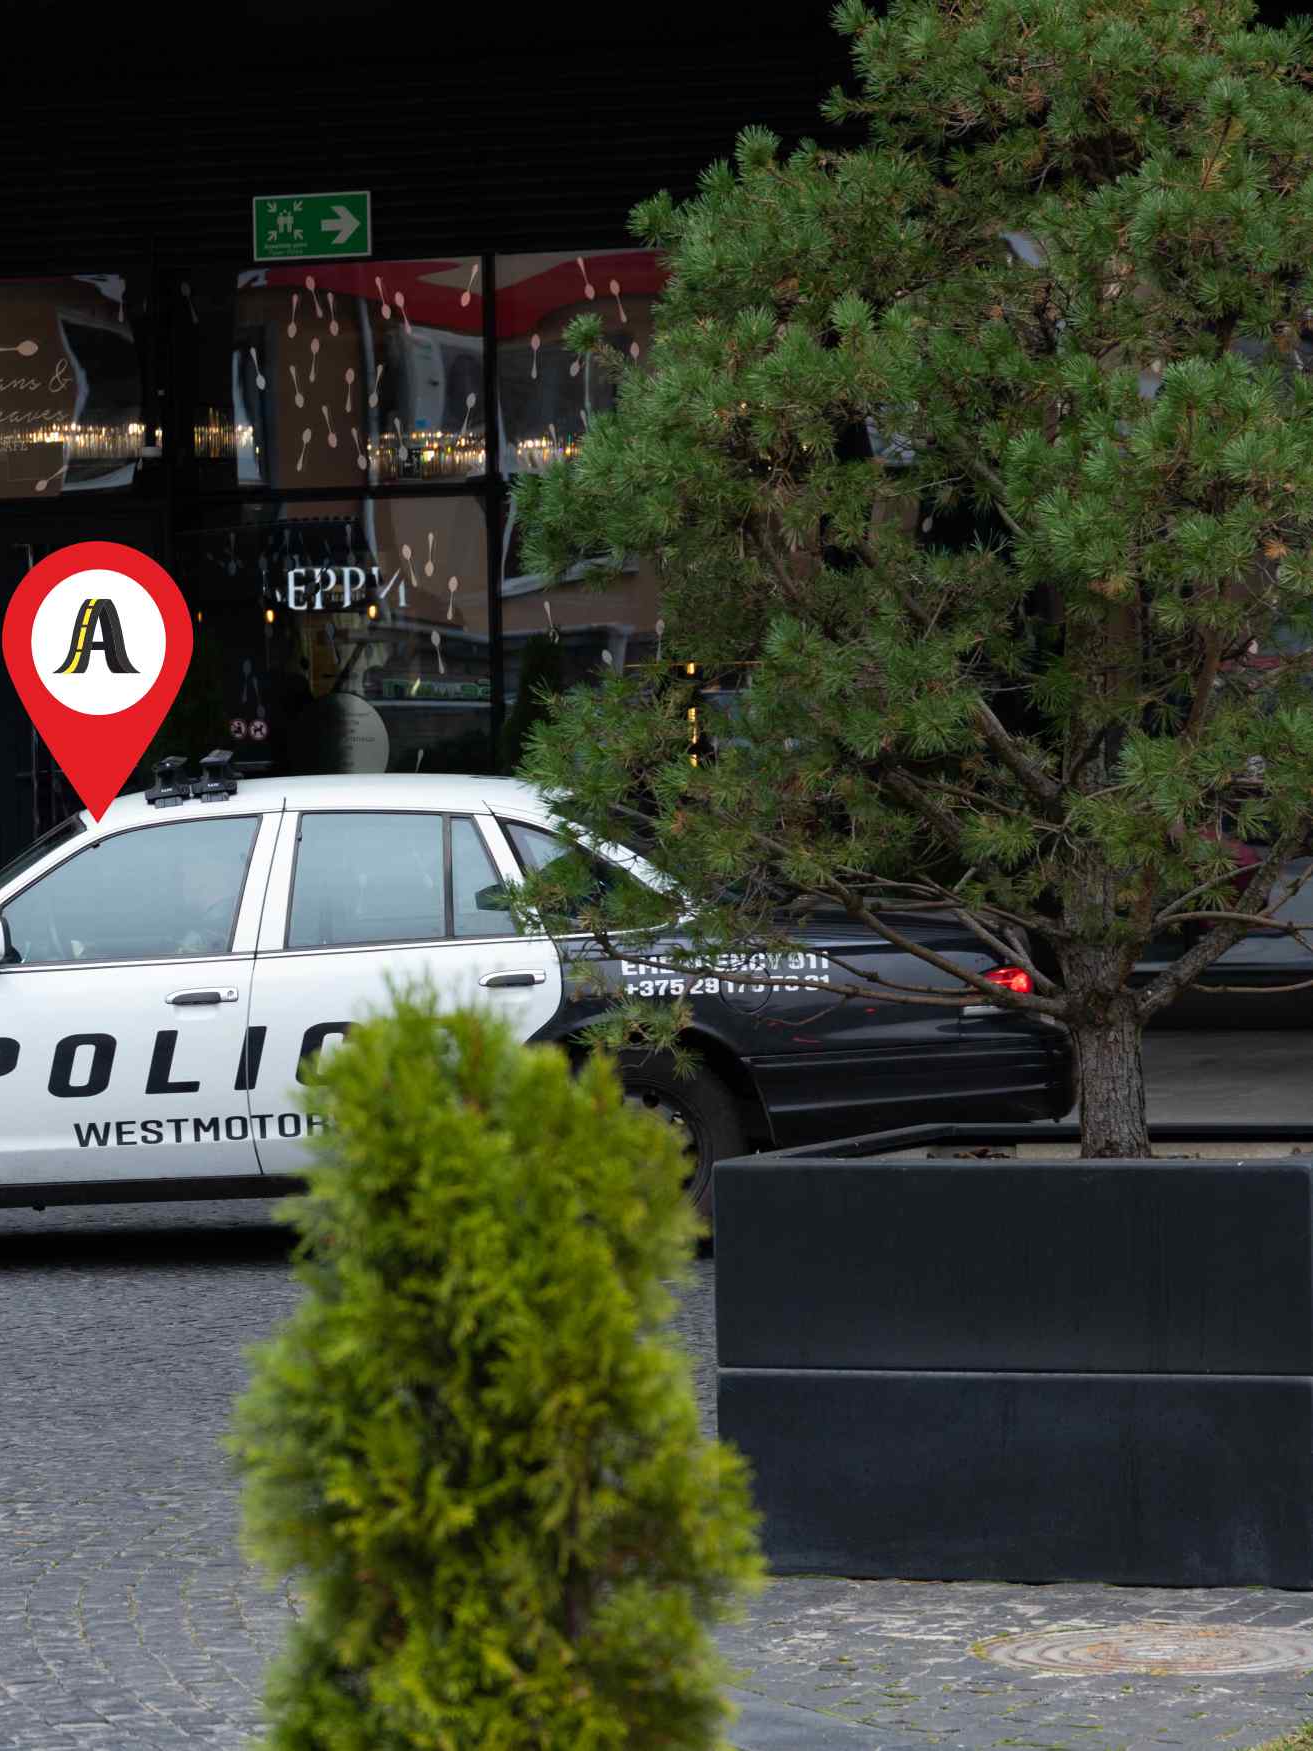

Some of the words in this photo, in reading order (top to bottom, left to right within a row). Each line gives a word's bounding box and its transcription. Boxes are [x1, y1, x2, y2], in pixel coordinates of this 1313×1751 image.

[48, 359, 72, 393] &
[788, 951, 830, 970] 911
[624, 978, 686, 997] +375
